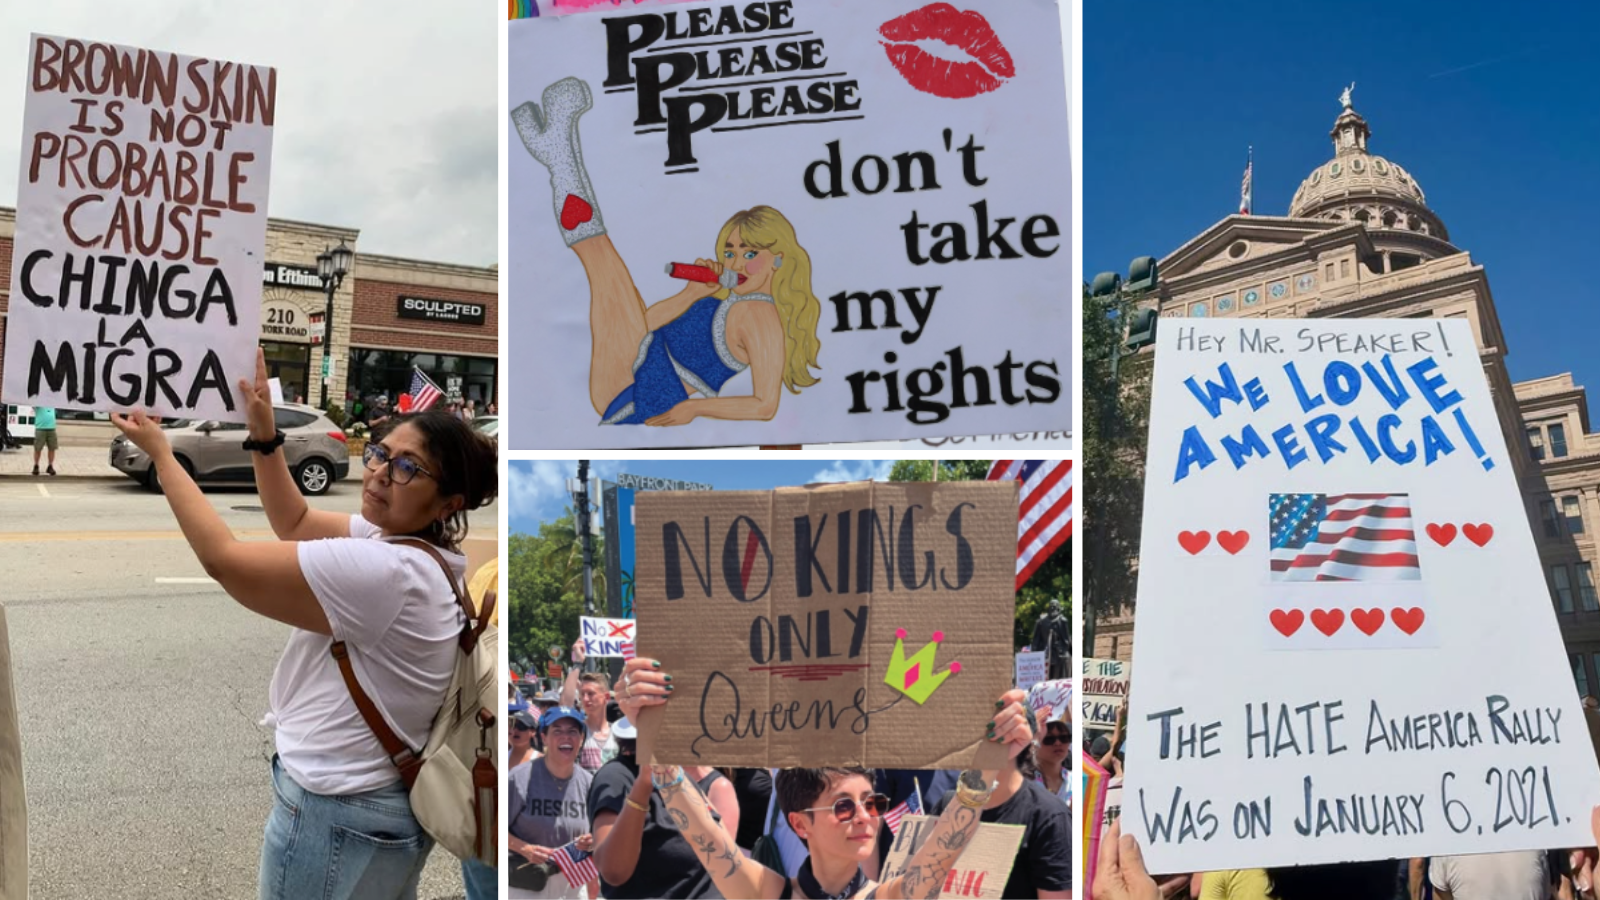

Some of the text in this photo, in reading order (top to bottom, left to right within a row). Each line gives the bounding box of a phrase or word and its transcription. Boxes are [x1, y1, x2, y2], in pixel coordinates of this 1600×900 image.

[601, 1, 795, 88] PLEASE
[32, 37, 277, 126] BROWN SKIN
[631, 38, 828, 127] PLEASE
[68, 98, 233, 150] IS NOT
[662, 79, 863, 167] PLEASE
[28, 131, 256, 213] PROBABLE
[803, 127, 989, 199] don't
[63, 194, 222, 266] CAUSE
[900, 199, 1060, 266] take
[20, 249, 238, 326] CHINGA
[266, 307, 295, 325] 210
[404, 298, 482, 316] SCULPTED
[828, 285, 942, 345] my
[97, 317, 155, 349] LA
[262, 324, 285, 335] YORK
[285, 326, 308, 337] ROAD
[27, 339, 236, 412] MIGRA
[845, 345, 1061, 426] rights
[1183, 353, 1467, 420] WE LOVE
[1172, 407, 1496, 485] AMERICA!
[618, 473, 713, 491] BAYFRONT PARK
[662, 502, 976, 602] NO KINGS
[749, 605, 869, 664] ONLY
[692, 670, 873, 757] Queens
[1147, 695, 1562, 760] THE HATE AMERICA RALLY
[530, 798, 587, 820] RESIST
[1138, 786, 1219, 845] WAS
[1233, 797, 1272, 839] ON
[1294, 775, 1425, 837] JANUARY
